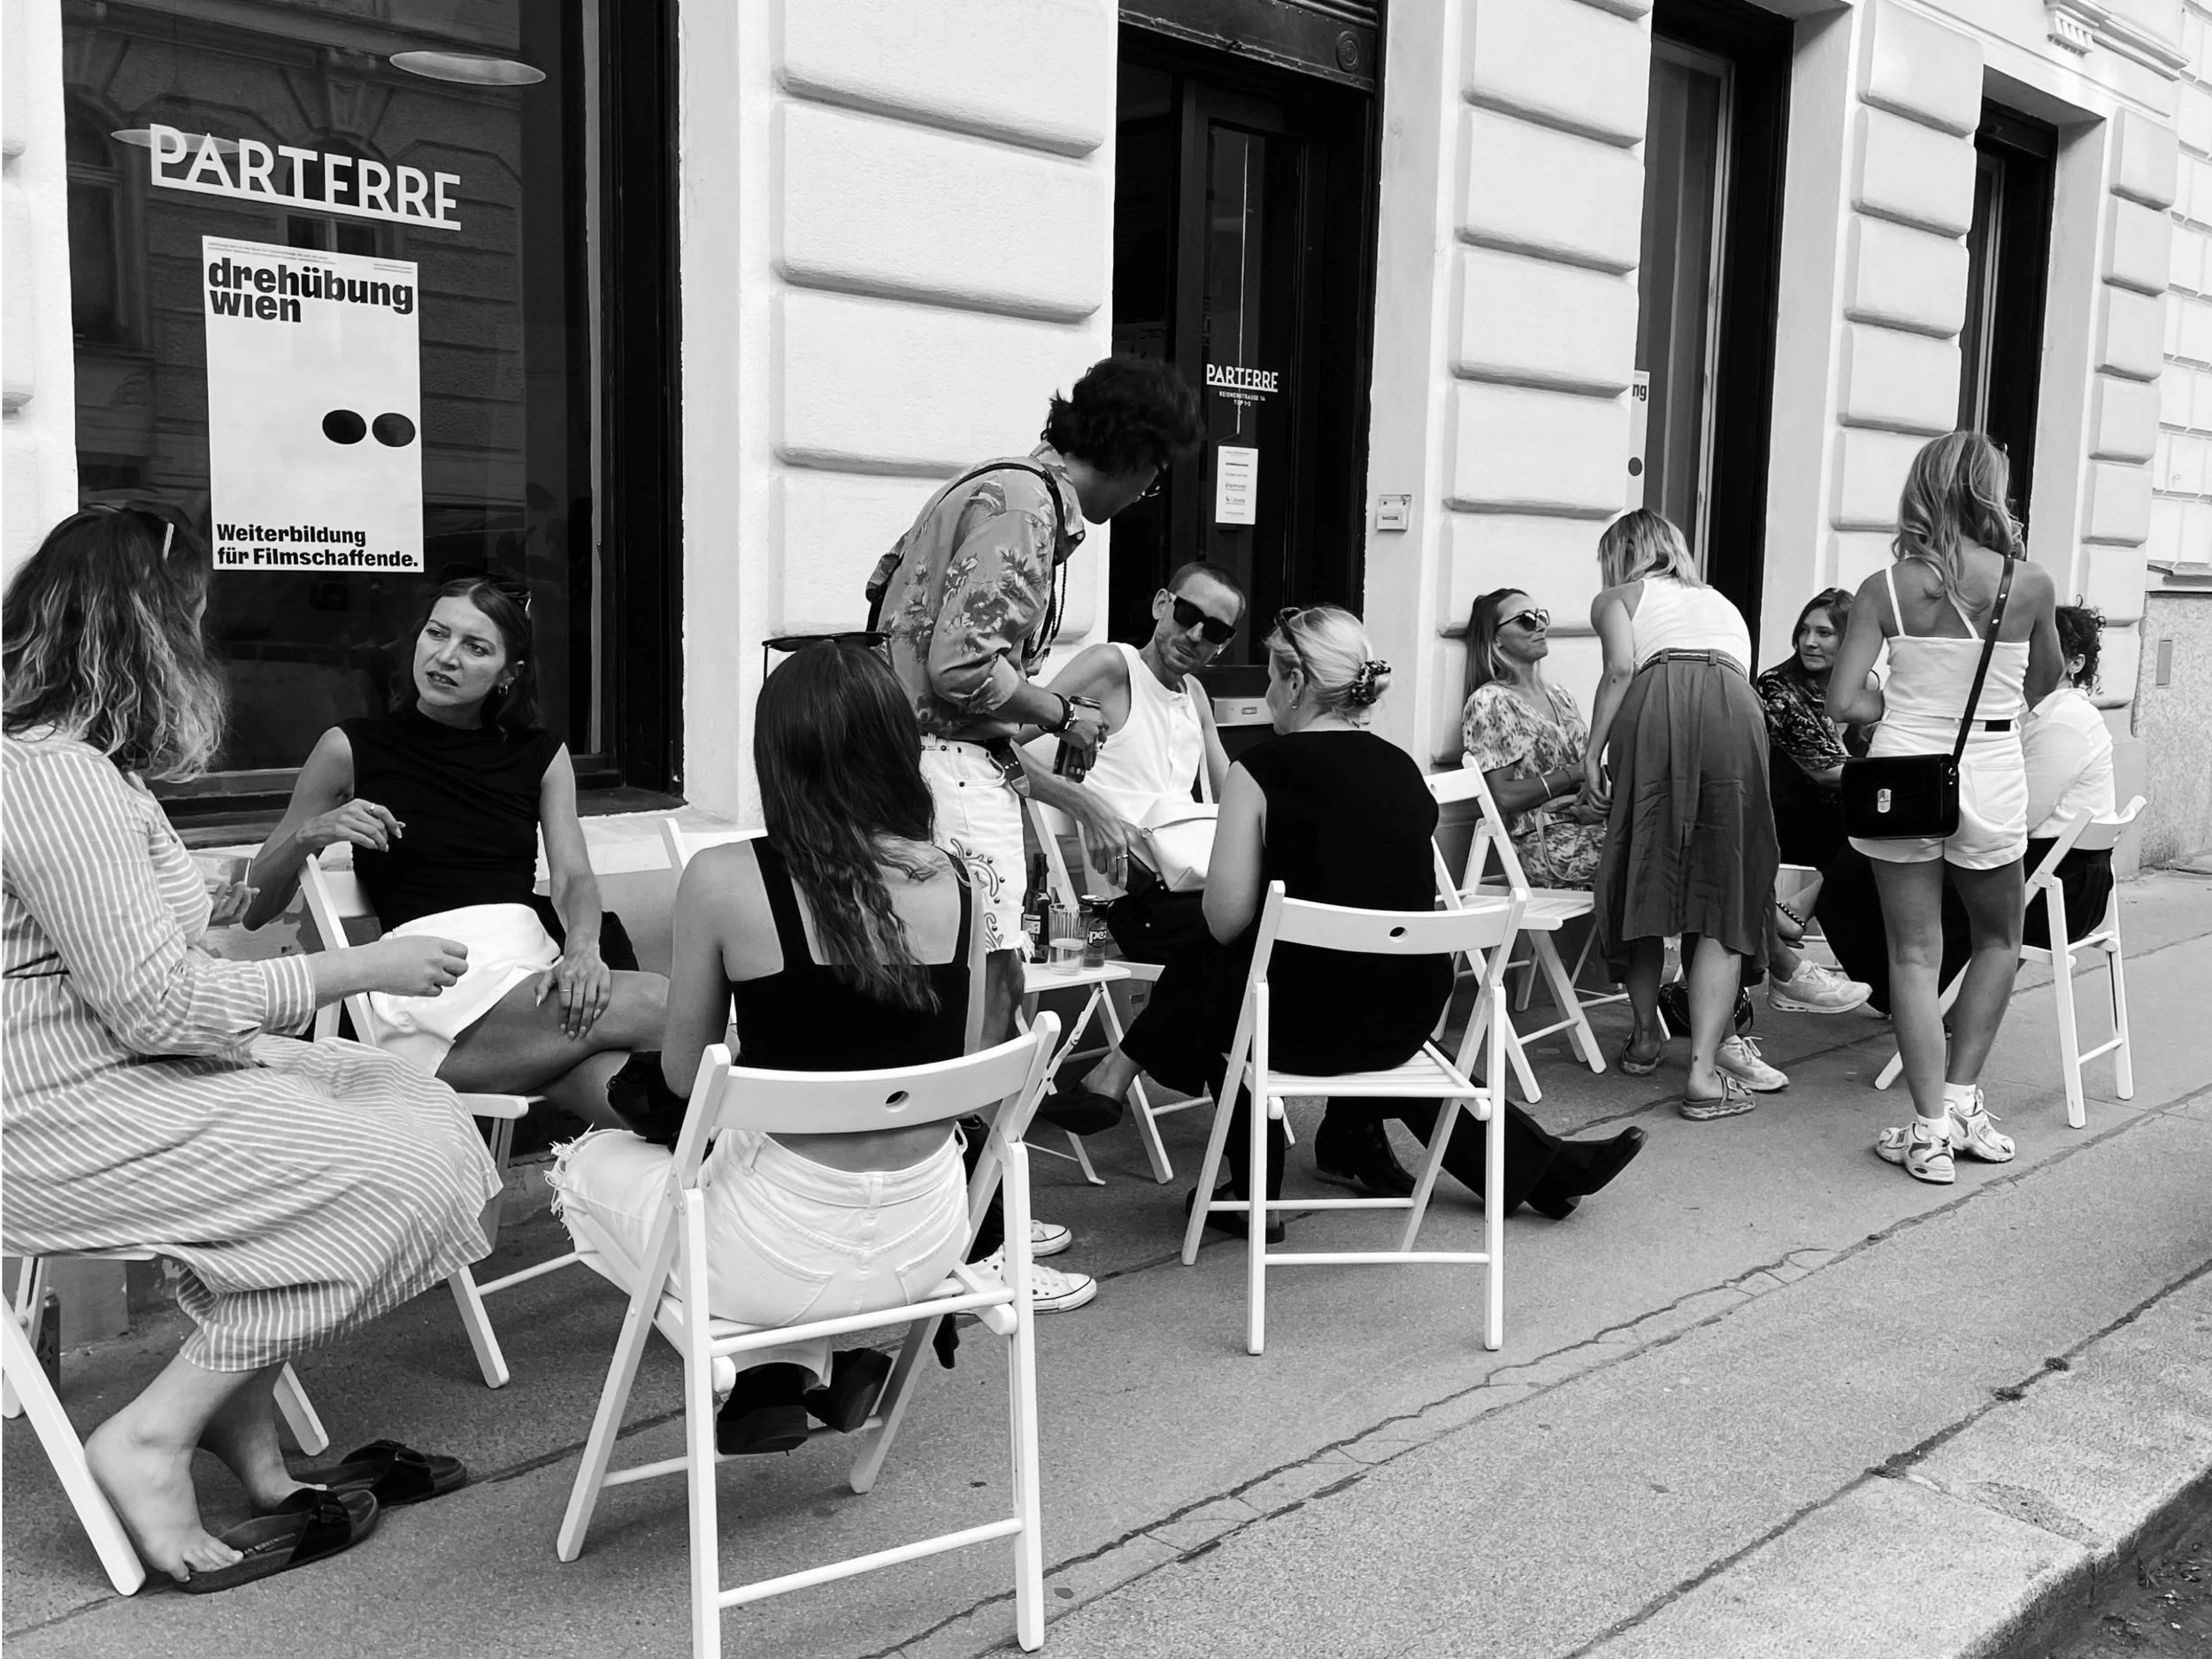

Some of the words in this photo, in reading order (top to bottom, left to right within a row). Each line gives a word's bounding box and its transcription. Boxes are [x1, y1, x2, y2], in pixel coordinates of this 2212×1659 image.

[150, 123, 461, 231] PARTERRE
[208, 257, 413, 315] drehübung
[209, 289, 302, 323] wien
[1206, 363, 1279, 392] PARTERRE
[217, 524, 366, 548] Weiterbildung
[218, 547, 249, 565] für
[253, 548, 419, 567] Filmschaffende.
